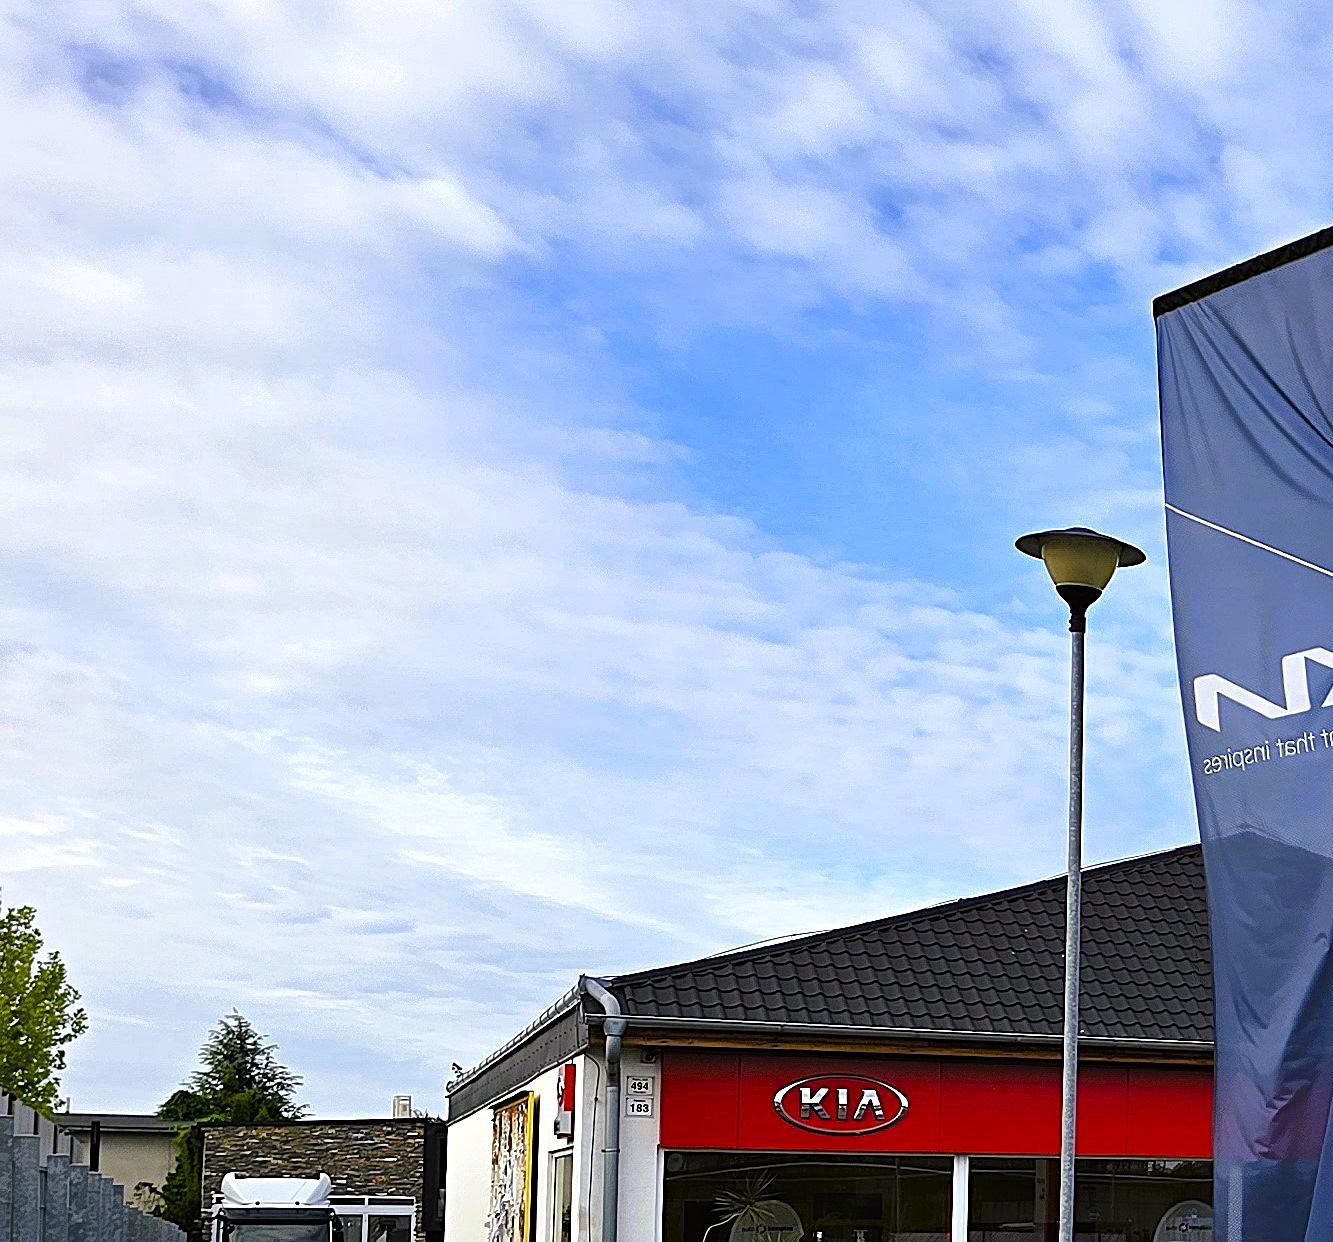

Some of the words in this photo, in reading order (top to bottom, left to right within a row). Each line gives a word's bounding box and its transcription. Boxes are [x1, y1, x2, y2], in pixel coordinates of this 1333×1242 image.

[631, 1081, 649, 1090] 494
[630, 1103, 649, 1112] 183
[799, 1087, 886, 1120] KIA
